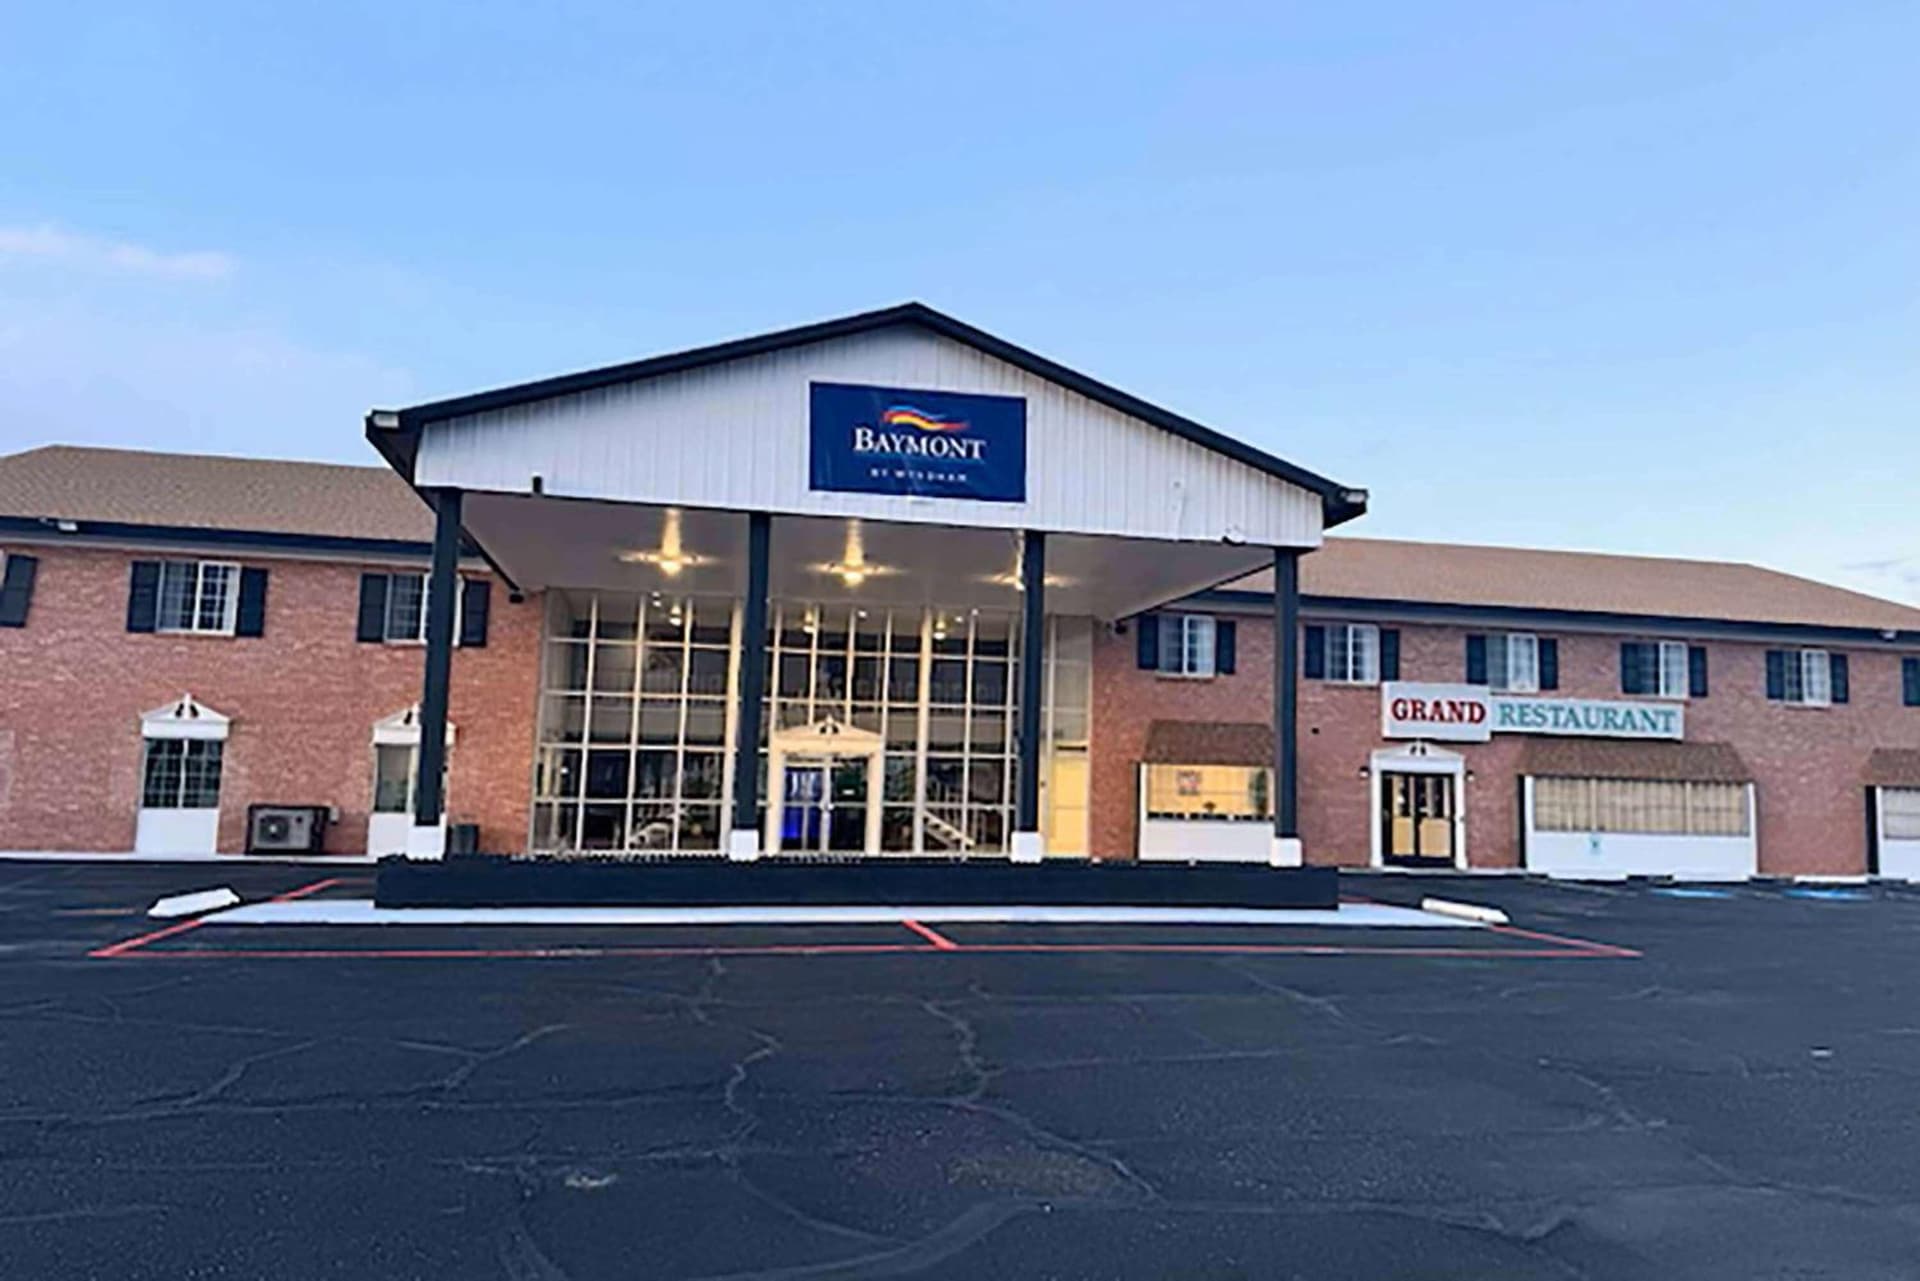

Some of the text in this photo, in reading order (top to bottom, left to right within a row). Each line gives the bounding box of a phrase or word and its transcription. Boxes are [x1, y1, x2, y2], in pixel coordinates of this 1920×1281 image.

[854, 427, 986, 459] BAYMONT
[1391, 699, 1676, 732] GRAND RESTAURANT
